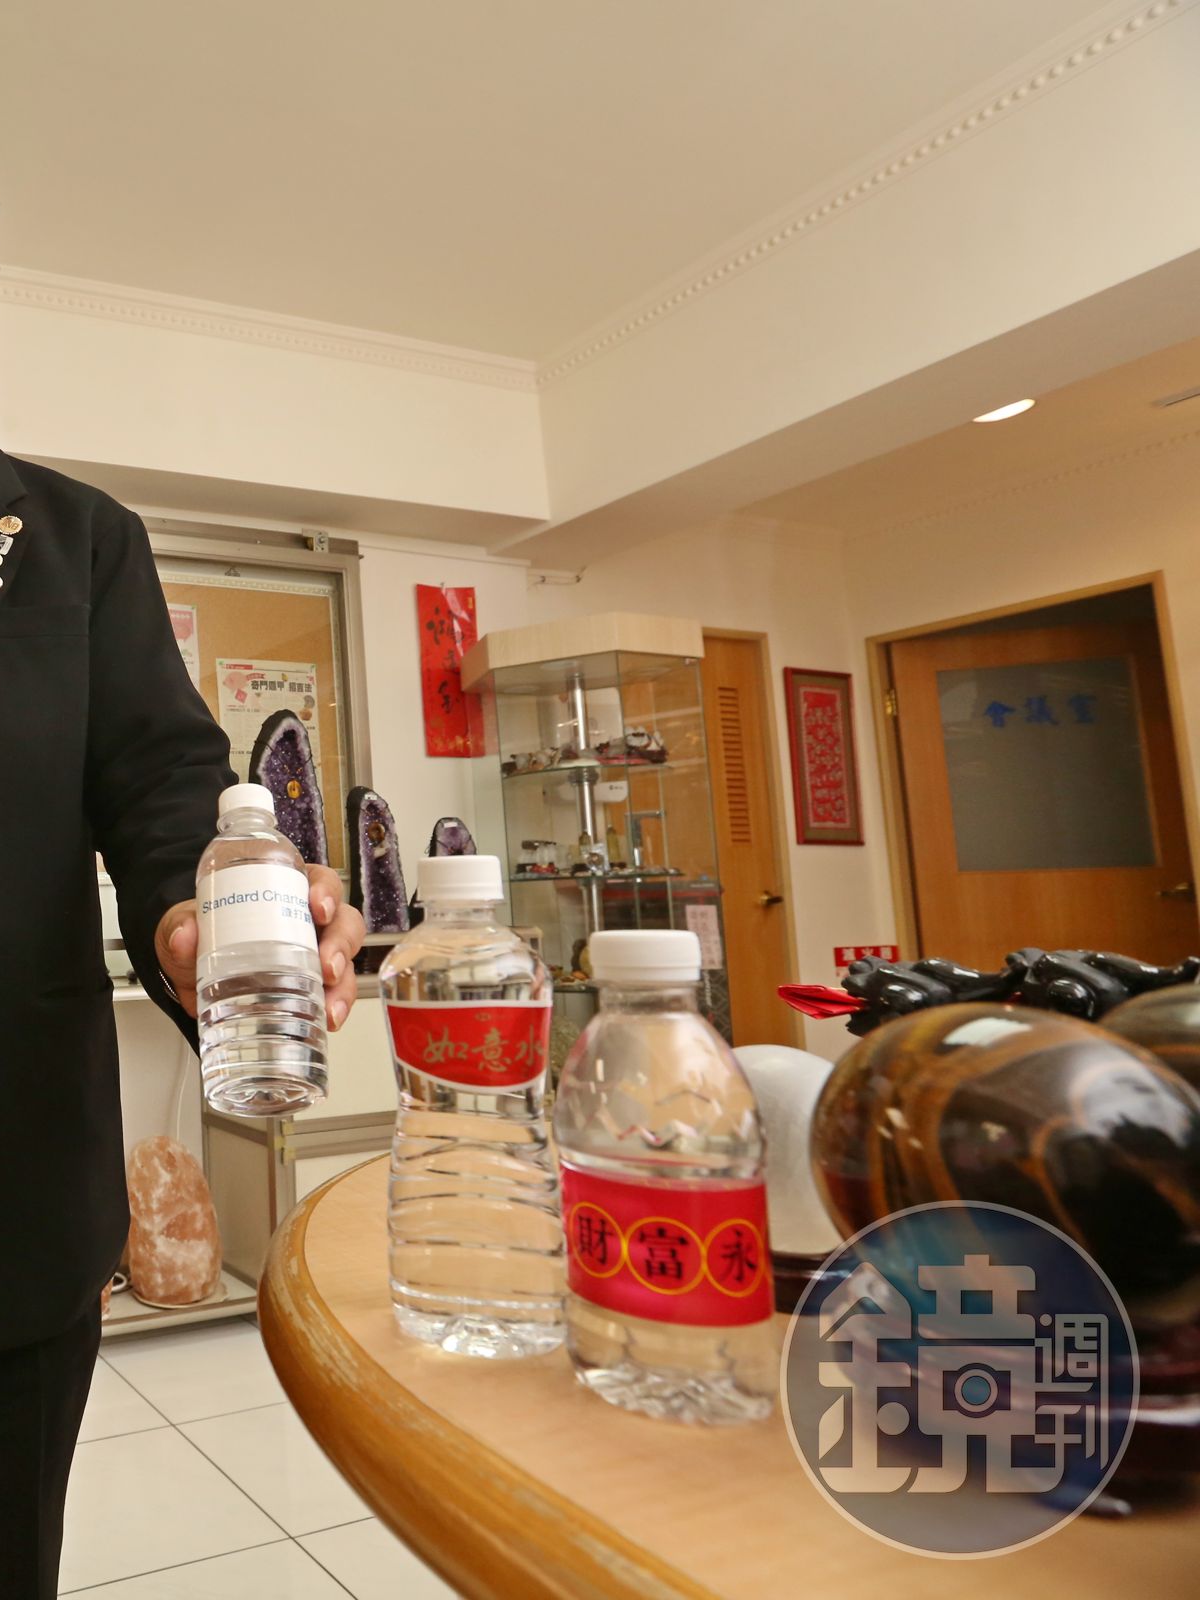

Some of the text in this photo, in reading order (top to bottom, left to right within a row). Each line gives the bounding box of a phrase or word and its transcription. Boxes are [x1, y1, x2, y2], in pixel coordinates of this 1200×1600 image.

[202, 890, 259, 914] Standard
[423, 1024, 544, 1073] 如意水
